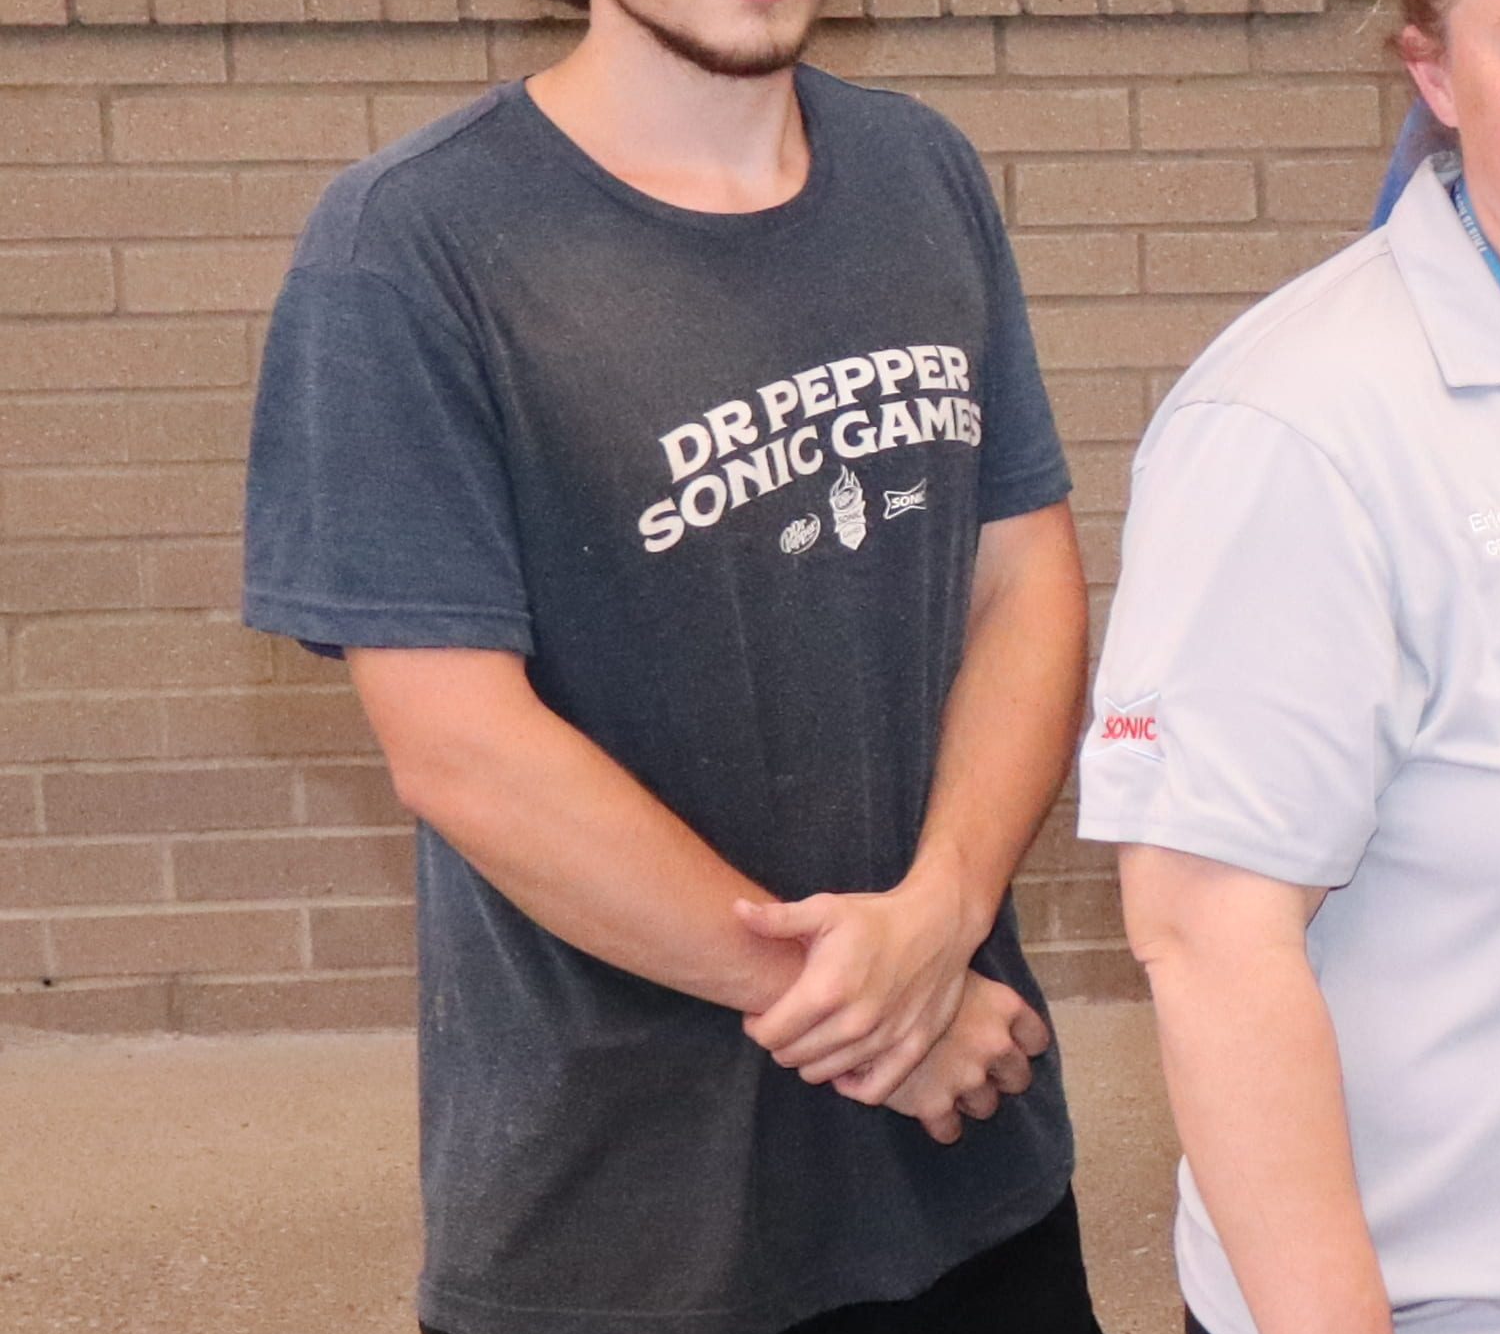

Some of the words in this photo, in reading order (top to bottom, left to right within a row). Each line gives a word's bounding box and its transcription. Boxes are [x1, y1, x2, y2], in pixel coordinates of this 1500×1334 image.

[638, 425, 824, 553] SONIC
[831, 397, 982, 460] GAMES
[659, 400, 758, 484] DR
[756, 345, 970, 435] PEPPER
[1102, 716, 1158, 741] SONIC
